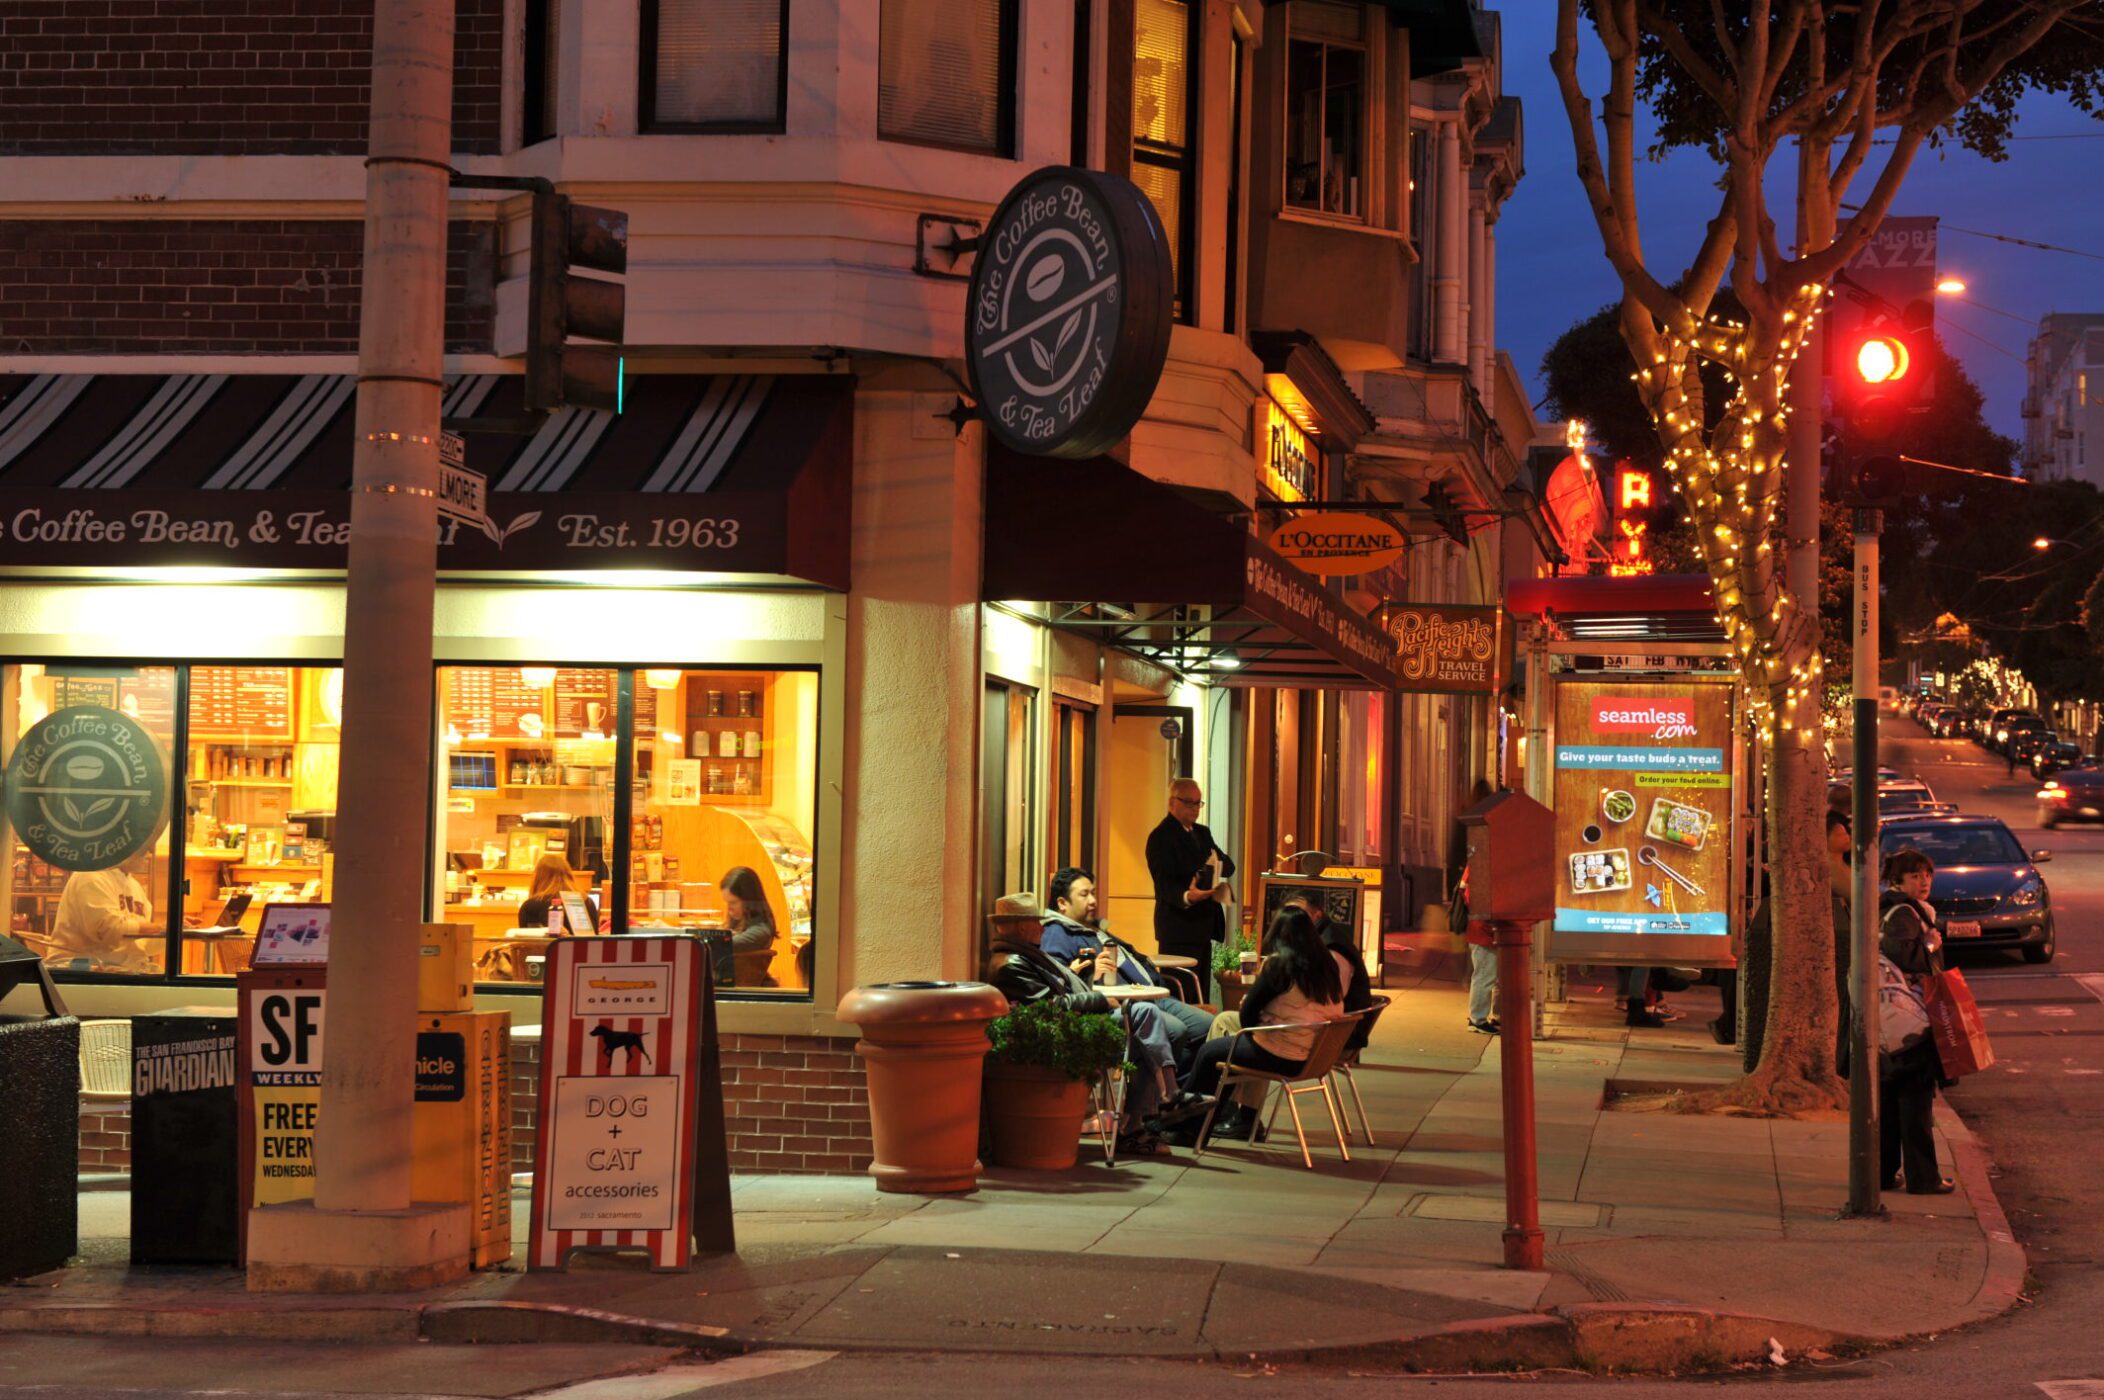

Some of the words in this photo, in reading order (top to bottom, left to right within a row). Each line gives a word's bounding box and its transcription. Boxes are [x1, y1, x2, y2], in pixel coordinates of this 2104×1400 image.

[977, 270, 1003, 335] The
[995, 192, 1057, 265] Coffee
[1061, 185, 1110, 270] Bean
[1856, 244, 1936, 269] AZZ
[1000, 395, 1018, 427] &
[1020, 405, 1056, 440] Tea
[1059, 336, 1109, 423] Leaf
[440, 470, 477, 511] LMORE
[12, 508, 126, 544] Coffee
[132, 510, 239, 548] Bean
[249, 510, 280, 542] &
[287, 511, 351, 545] Tea
[557, 514, 638, 549] Est.
[647, 518, 740, 549] 1963
[1389, 611, 1447, 656] Pacific
[1404, 618, 1494, 680] Heights
[1438, 672, 1486, 681] SERVICE
[1439, 661, 1486, 671] TRAVEL
[1599, 708, 1686, 723] seamless
[1650, 724, 1697, 740] .com
[16, 743, 46, 780] The
[42, 719, 107, 744] Coffee
[110, 722, 149, 784] Bean
[1559, 751, 1585, 763] Give
[1588, 752, 1613, 765] your
[1616, 752, 1645, 763] taste
[1648, 751, 1676, 763] buds
[1679, 755, 1686, 763] a
[1688, 753, 1720, 764] treat.
[1639, 775, 1659, 784] Order
[1661, 777, 1678, 786] your
[1680, 776, 1696, 784] food
[28, 824, 46, 844] &
[48, 834, 81, 862] Tea
[83, 820, 132, 861] Leaf
[260, 994, 322, 1067] SF
[136, 1045, 152, 1059] THE
[152, 1043, 170, 1057] SAN
[218, 1035, 235, 1049] BAY
[135, 1048, 235, 1097] GUARDIAN
[257, 1072, 323, 1086] WEEKLY
[263, 1103, 318, 1130] FREE
[585, 1094, 648, 1119] DOG
[608, 1125, 622, 1139] +
[585, 1148, 643, 1172] CAT
[565, 1182, 659, 1198] accessories
[597, 1211, 643, 1219] sacramento
